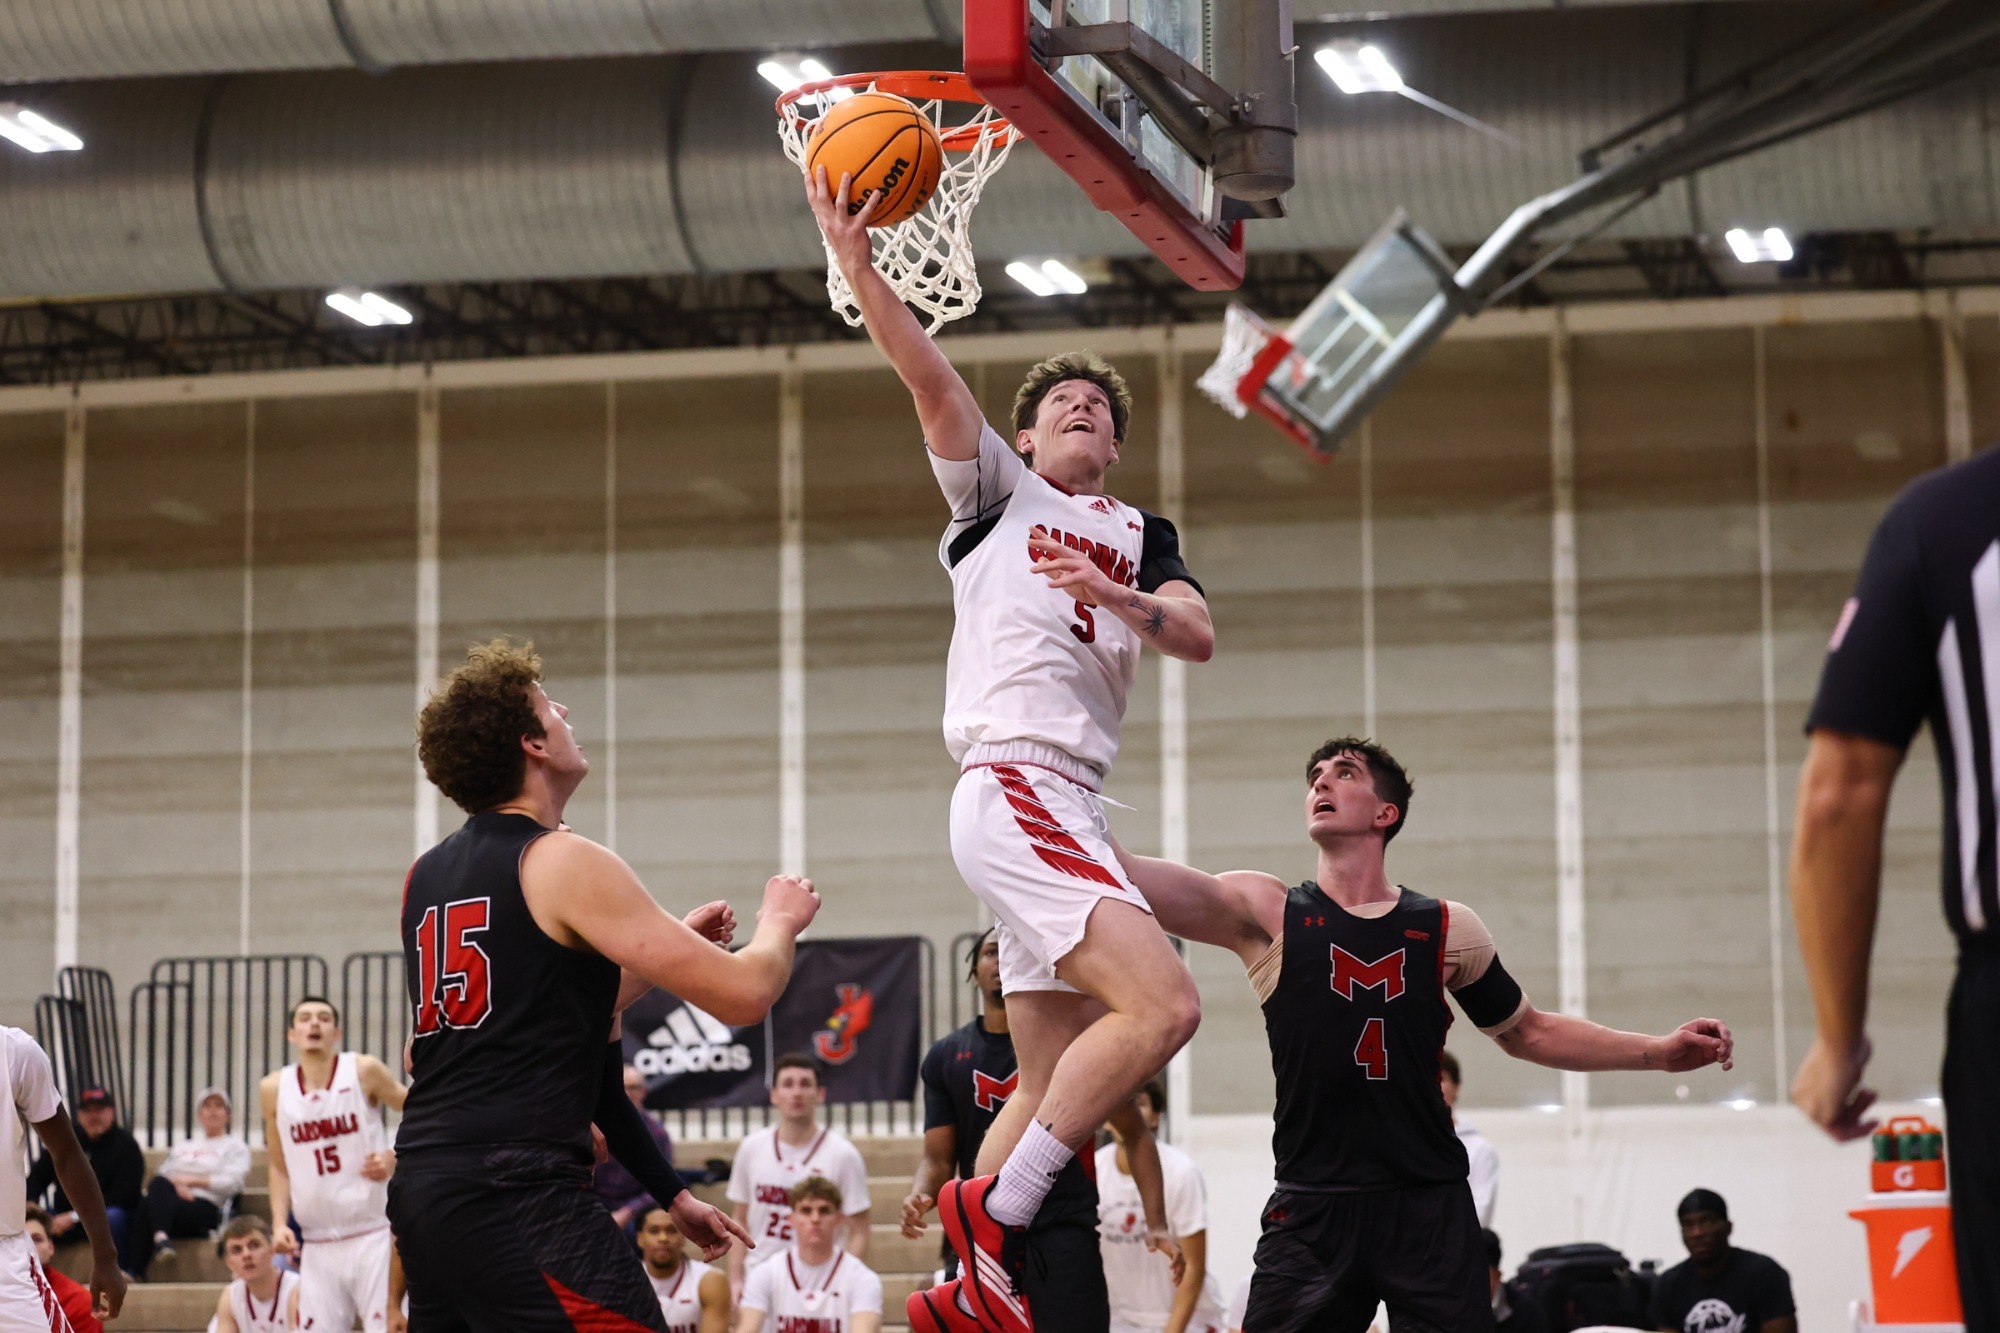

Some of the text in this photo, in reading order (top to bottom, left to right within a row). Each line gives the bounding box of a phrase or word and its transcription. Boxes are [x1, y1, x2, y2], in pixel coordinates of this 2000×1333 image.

[1070, 600, 1098, 644] 5
[415, 897, 492, 1038] 15
[1330, 943, 1405, 1003] M
[634, 1042, 752, 1075] adidas
[1354, 1018, 1388, 1081] 4
[314, 1145, 341, 1176] 15
[1893, 1164, 1915, 1188] G
